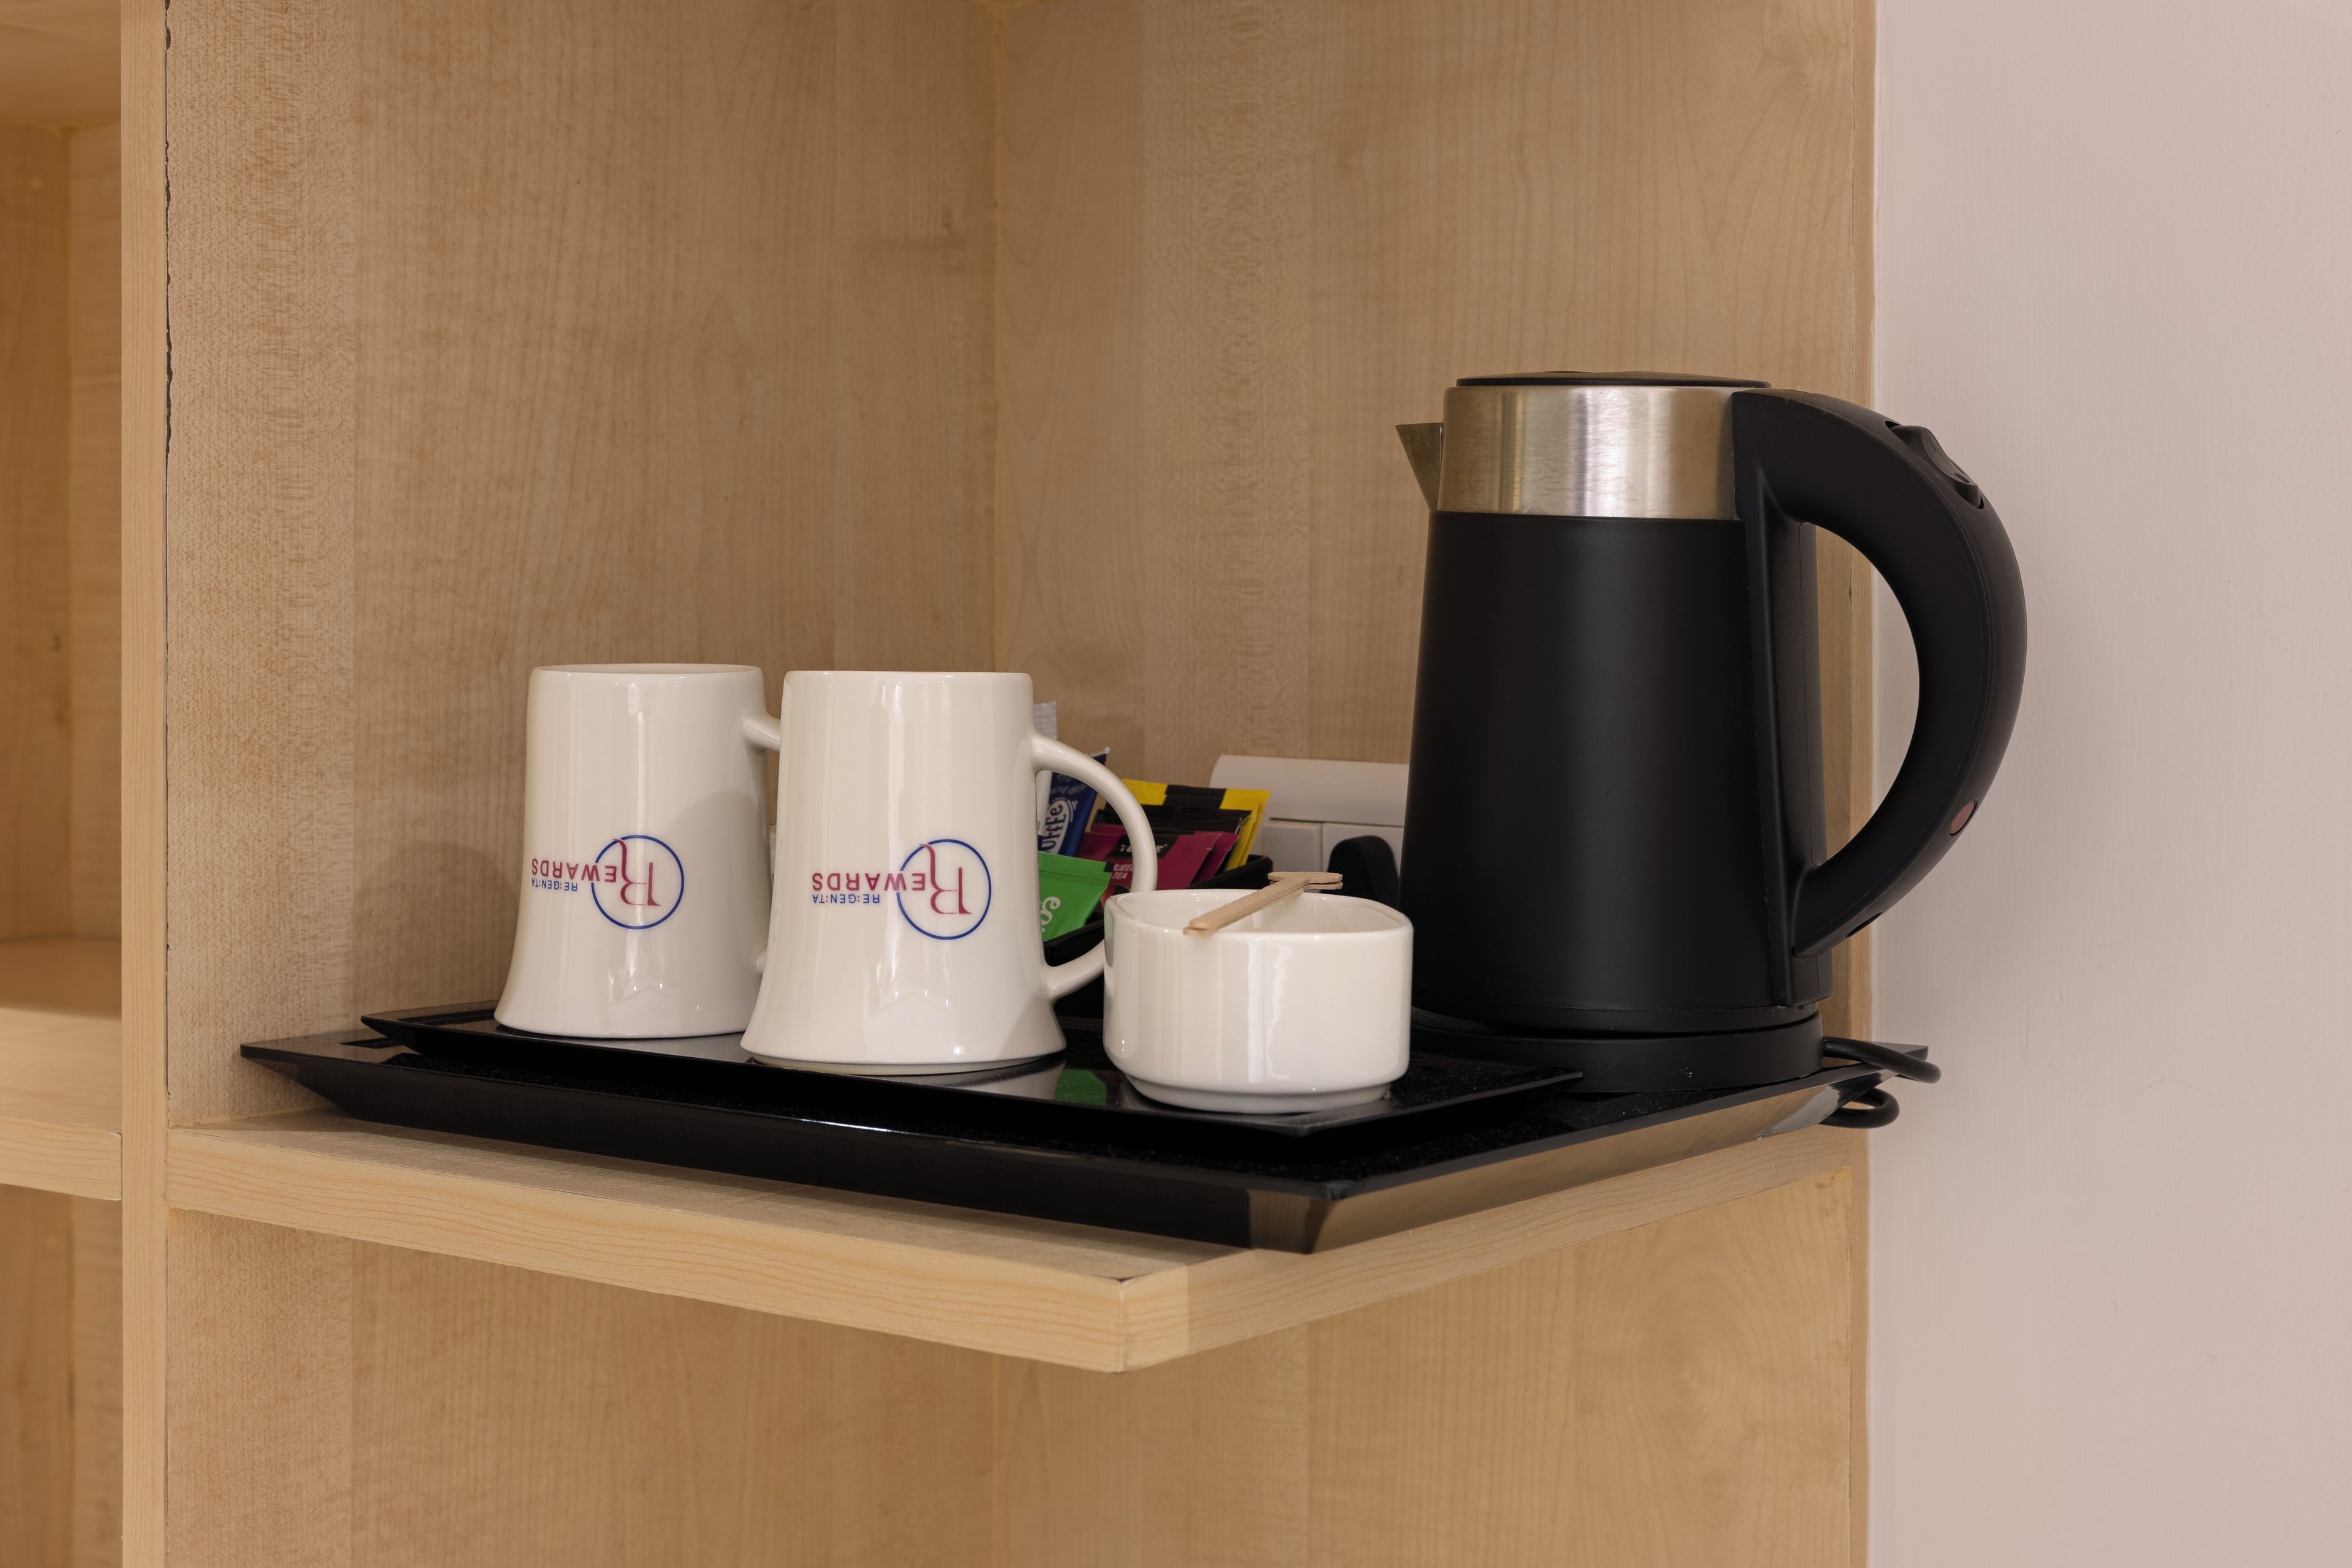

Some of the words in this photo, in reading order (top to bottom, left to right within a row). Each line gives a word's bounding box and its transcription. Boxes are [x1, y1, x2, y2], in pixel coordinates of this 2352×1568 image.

[532, 839, 662, 906] REWARDS
[532, 878, 578, 892] RE:GEN:TA
[812, 843, 972, 914] REWARDS
[812, 894, 880, 903] RE:GEN:TA
